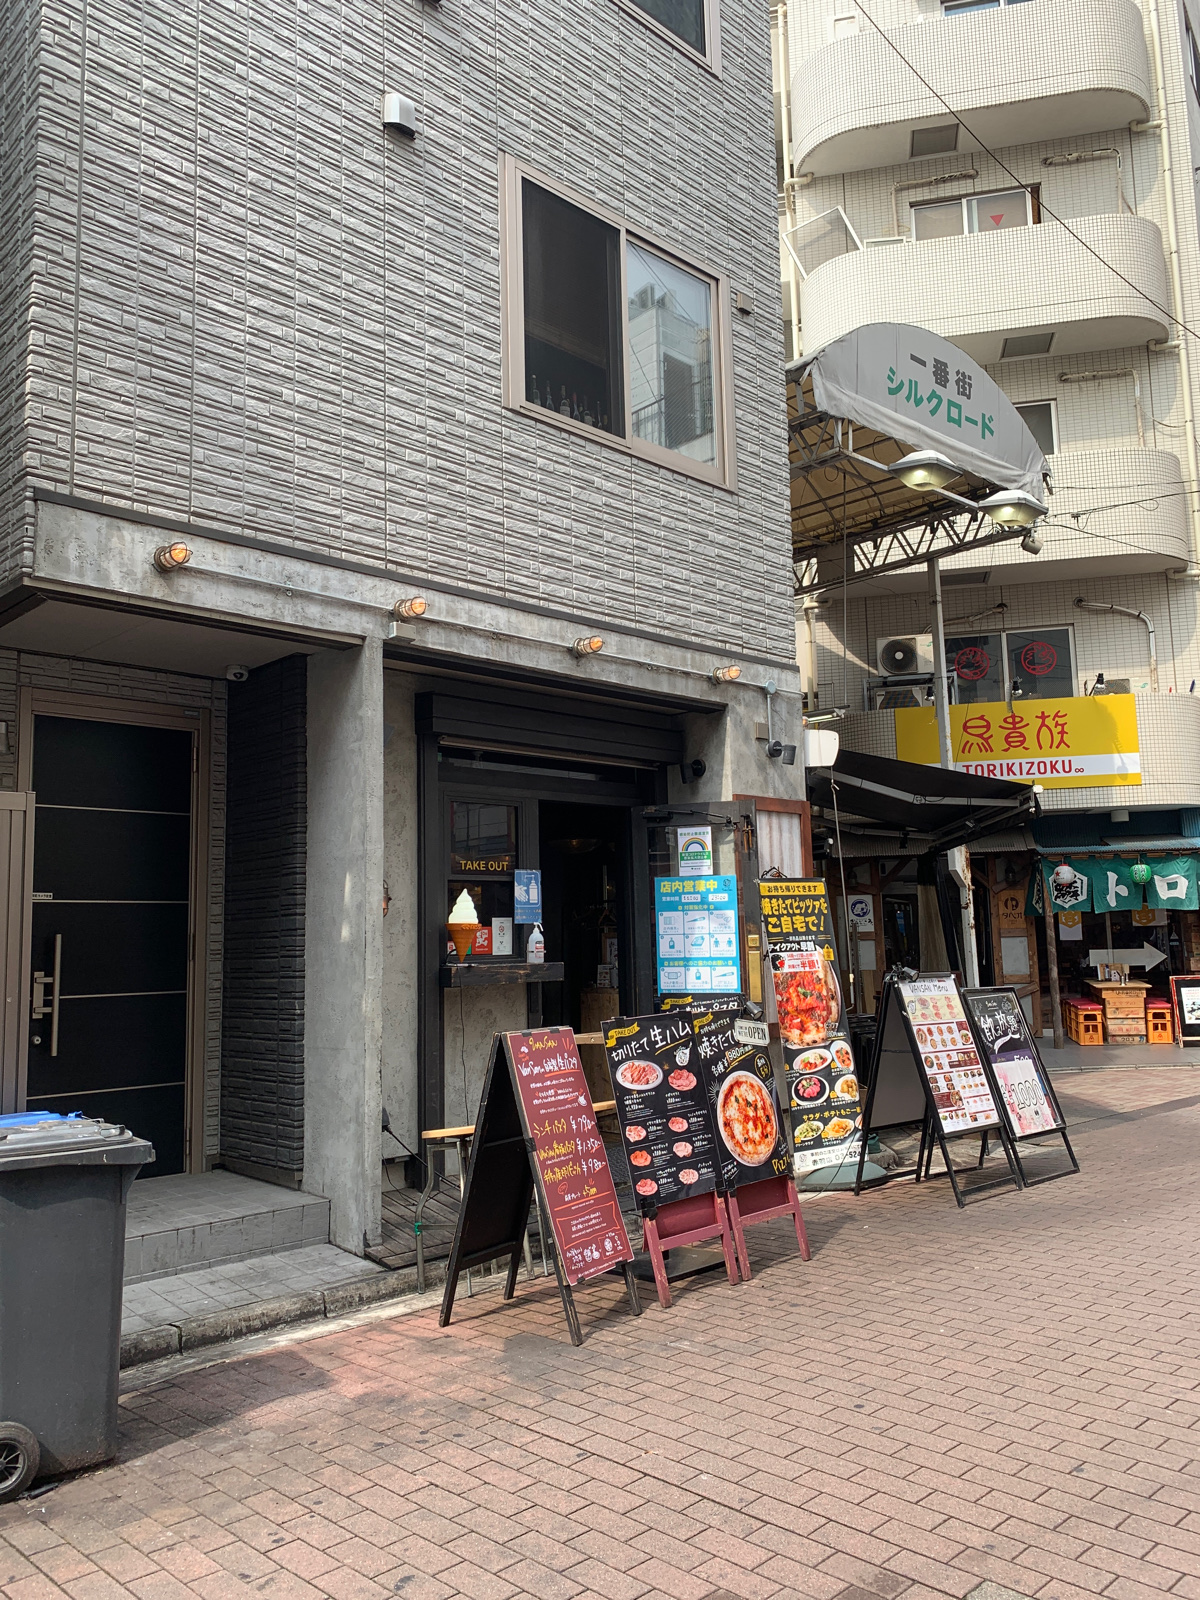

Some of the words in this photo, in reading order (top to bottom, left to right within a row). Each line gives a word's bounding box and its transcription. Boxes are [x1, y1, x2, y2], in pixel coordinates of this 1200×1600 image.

[909, 352, 973, 400] 一番街
[886, 366, 995, 440] シルクロード
[961, 709, 1071, 754] 鳥貴族
[961, 759, 1073, 779] TORIKIZOKU
[460, 861, 486, 870] TAKE
[488, 861, 509, 871] OUT
[660, 879, 718, 893] 店内営業中
[767, 885, 818, 893] お持ち帰りできます
[761, 897, 828, 915] 焼きたてピッツァを
[768, 915, 825, 933] ご自宅で！
[748, 1026, 767, 1041] OPEN
[1010, 1078, 1045, 1110] 1000
